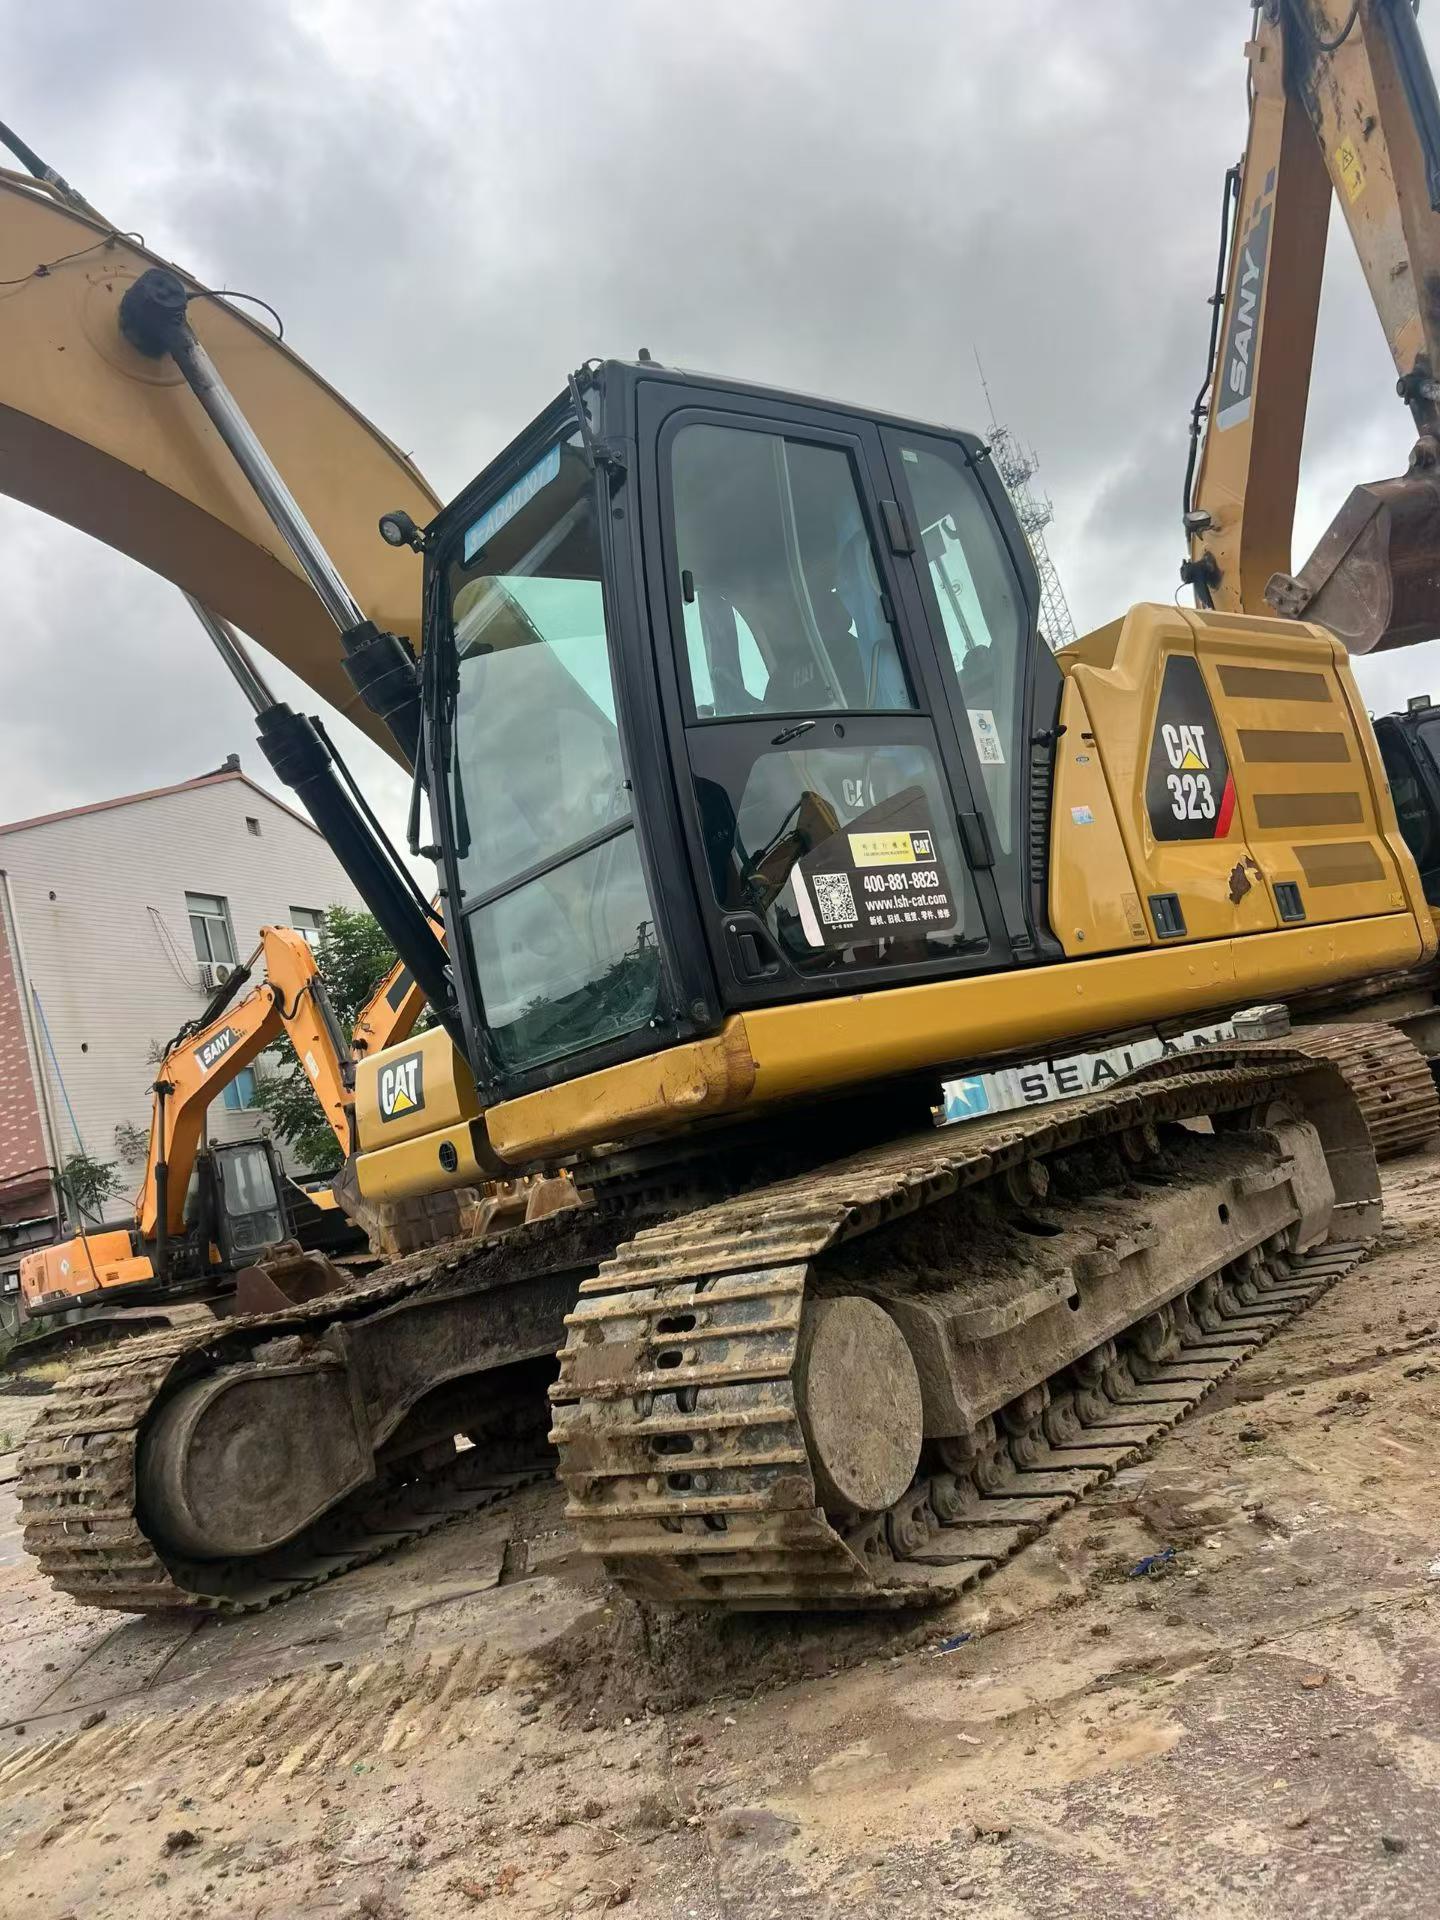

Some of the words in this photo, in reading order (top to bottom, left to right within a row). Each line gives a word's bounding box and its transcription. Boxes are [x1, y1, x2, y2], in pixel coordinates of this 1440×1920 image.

[1230, 247, 1260, 396] SANY
[1161, 723, 1210, 769] CAT
[1166, 774, 1216, 820] 323
[913, 839, 930, 855] CAT
[863, 871, 940, 893] 400-881-8829
[865, 894, 947, 911] www.lsh-cat.com
[203, 1029, 231, 1065] SANY
[381, 1058, 418, 1115] CAT
